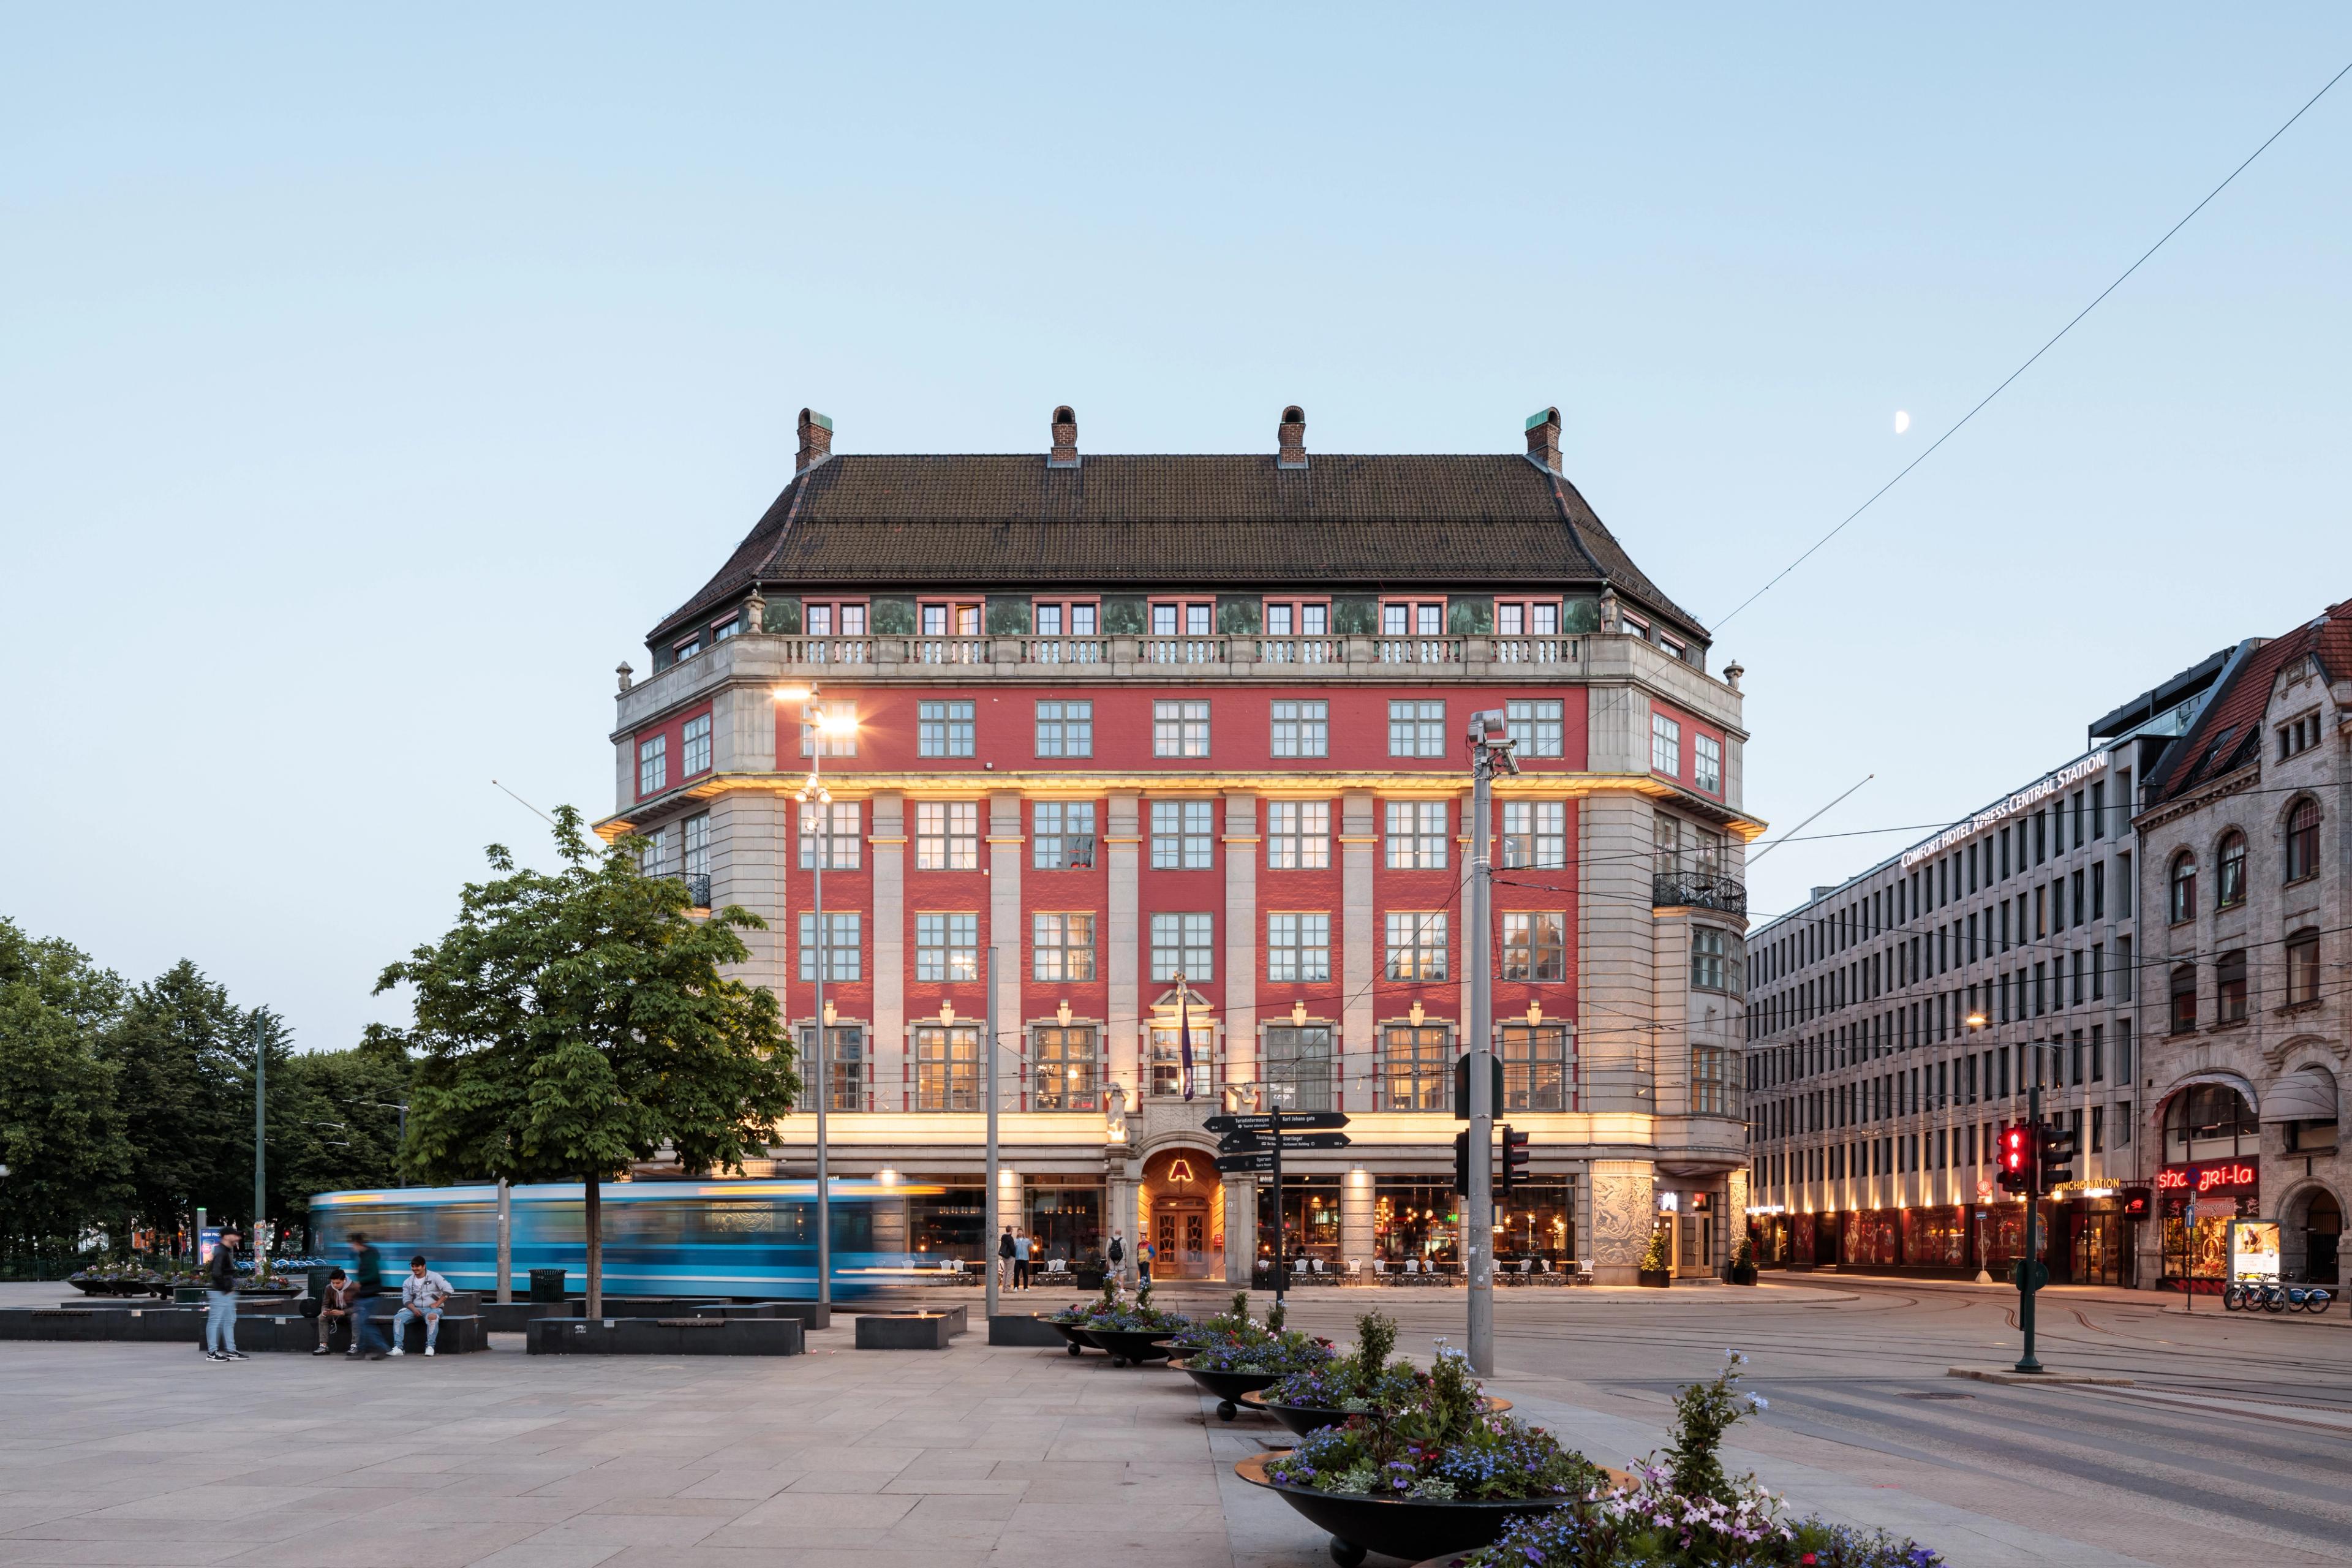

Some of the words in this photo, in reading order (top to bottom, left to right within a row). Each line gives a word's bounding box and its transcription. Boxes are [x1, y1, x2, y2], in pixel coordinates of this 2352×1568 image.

[1901, 837, 1941, 868] COMFORT
[1942, 823, 1972, 849] HOTEL
[1972, 802, 2010, 833] XPRESS
[2008, 778, 2056, 814] CENTRAL
[2057, 750, 2108, 790] STATION
[1169, 1159, 1193, 1182] A
